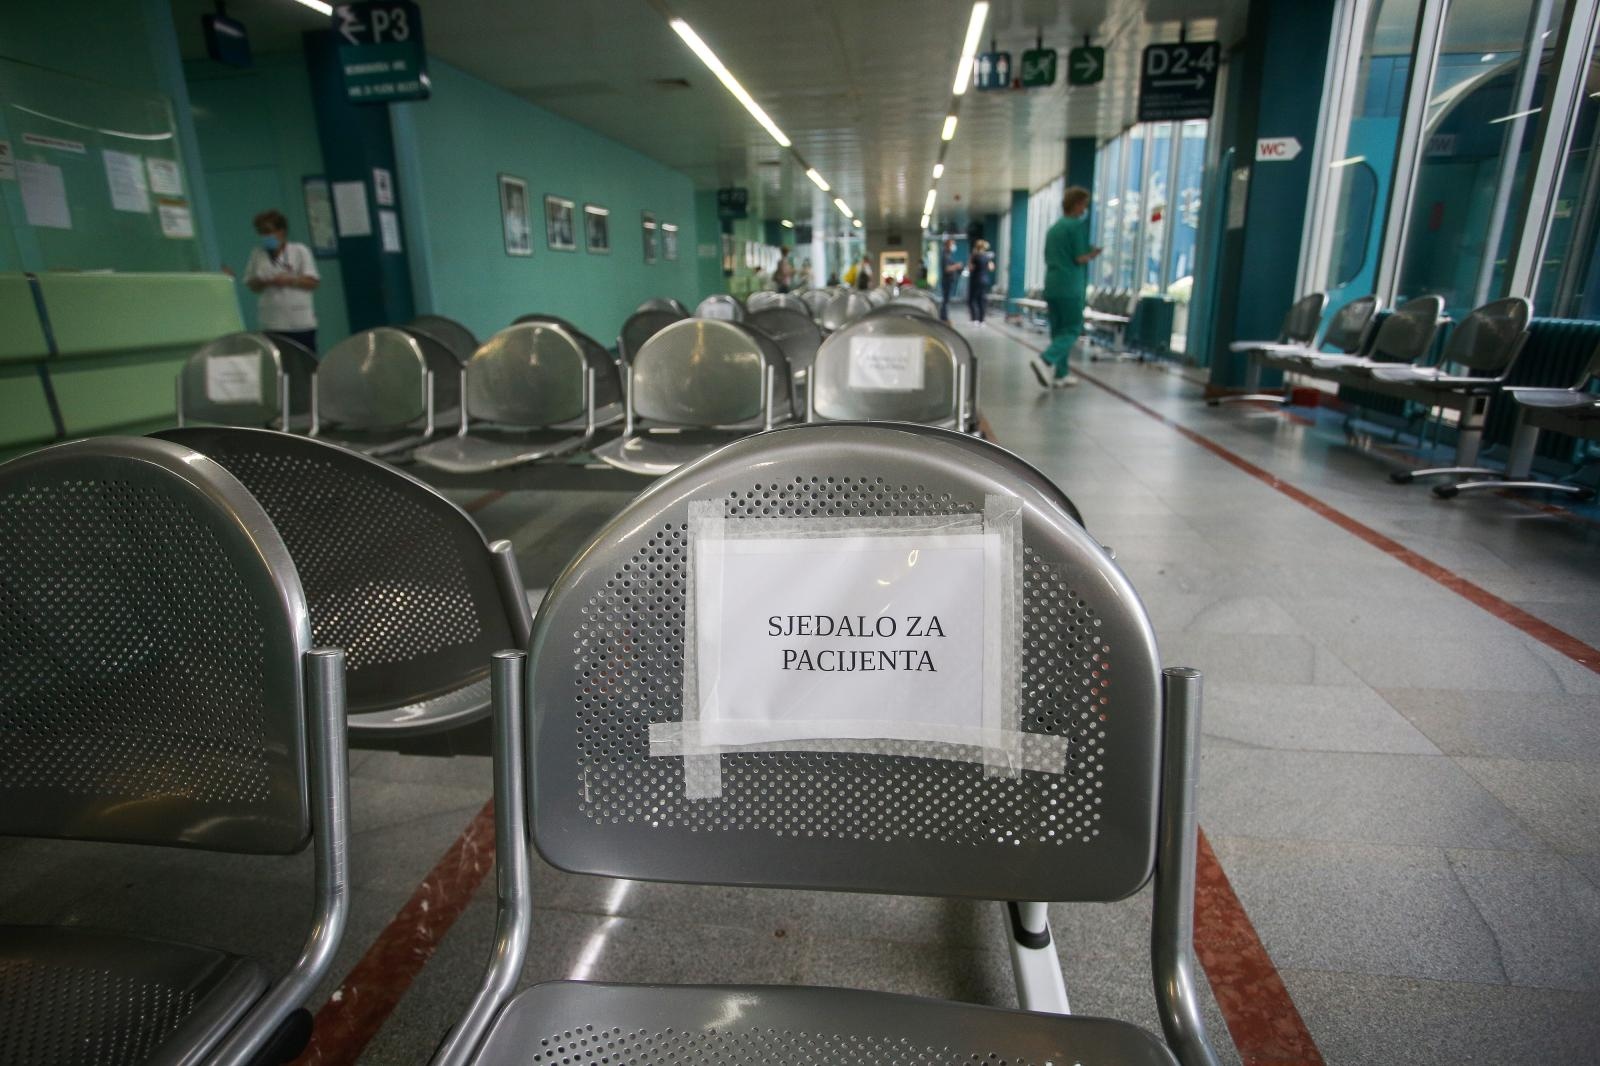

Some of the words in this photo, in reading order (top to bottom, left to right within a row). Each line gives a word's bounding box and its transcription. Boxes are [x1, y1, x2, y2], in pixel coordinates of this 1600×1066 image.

[371, 8, 409, 43] P3
[1261, 142, 1285, 156] WC
[768, 615, 897, 638] SJEDALO
[906, 615, 947, 638] ZA
[781, 649, 938, 673] PACIJENTA
